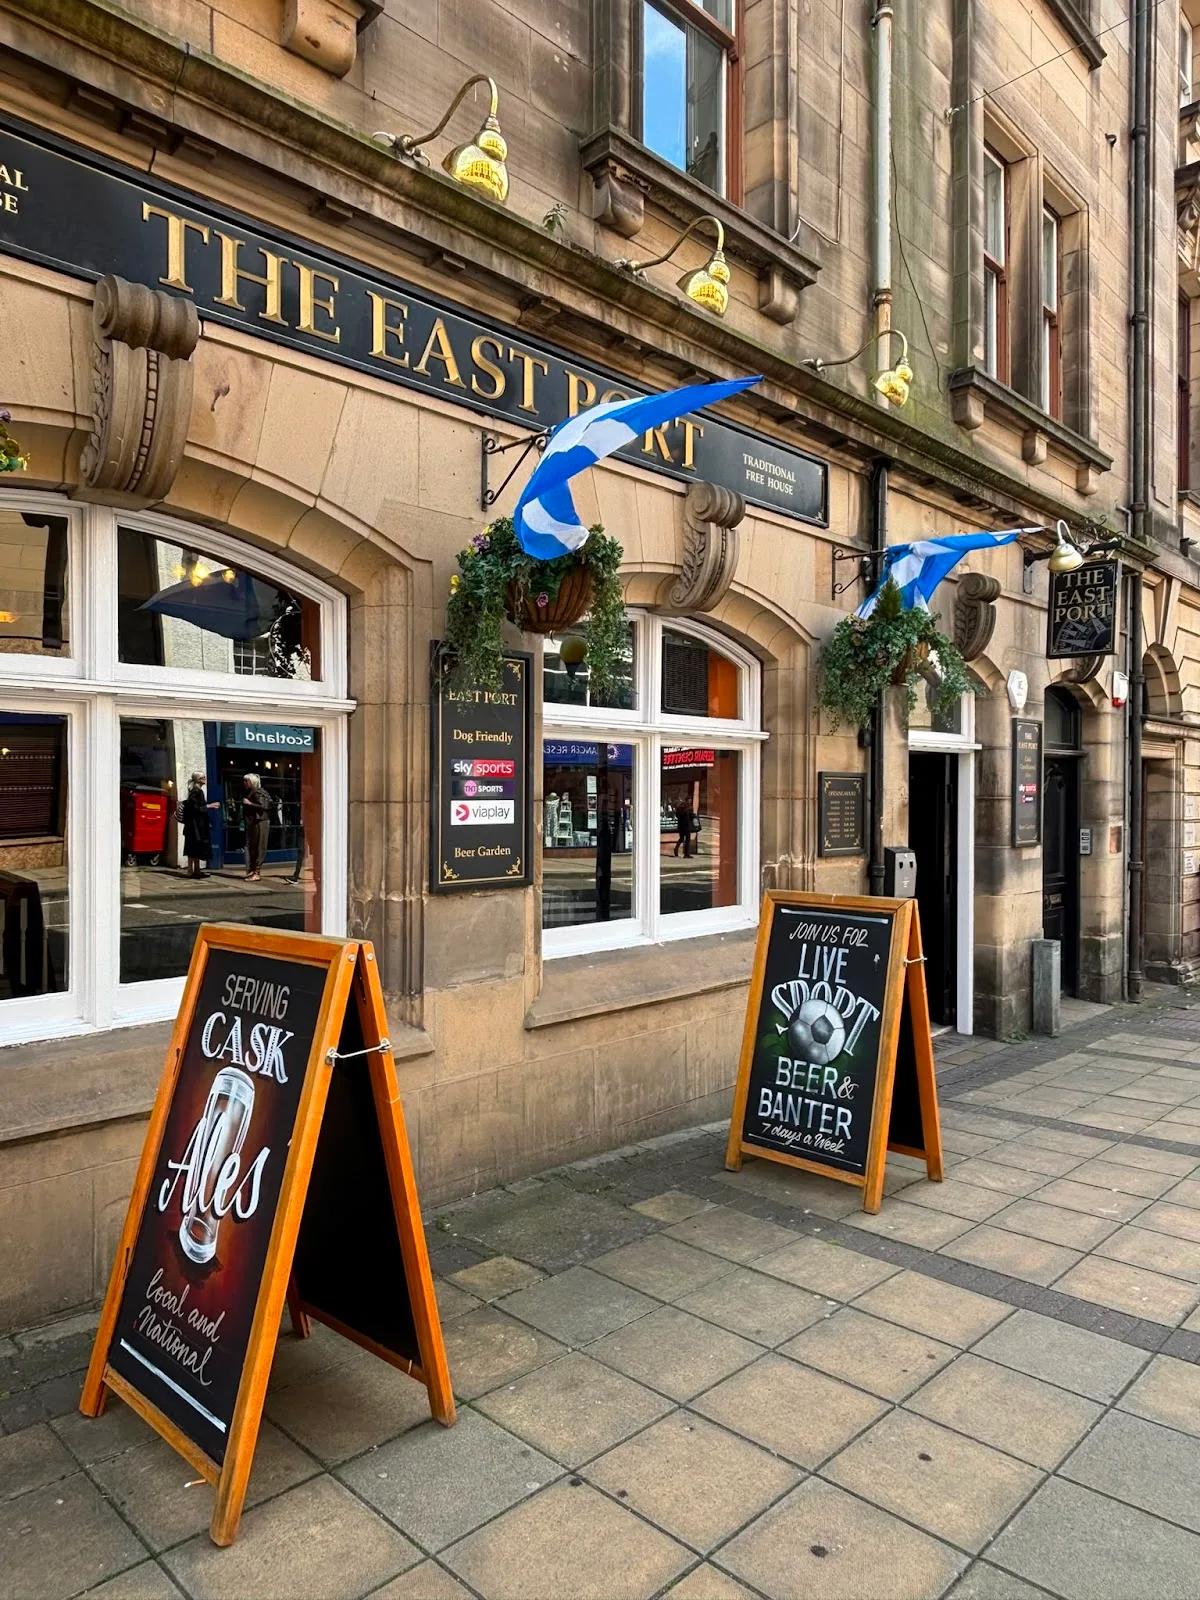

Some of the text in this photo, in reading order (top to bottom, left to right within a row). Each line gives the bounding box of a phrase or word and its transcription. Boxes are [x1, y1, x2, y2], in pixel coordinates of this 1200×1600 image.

[142, 201, 704, 471] THE EAST PRT
[743, 453, 796, 482] TRADITIONAL
[746, 469, 793, 496] FREE HOUSE
[1062, 569, 1104, 588] THE
[1057, 586, 1110, 606] EAST
[1055, 603, 1111, 623] PORT
[449, 688, 518, 706] EAST PORT
[453, 729, 513, 746] Dog Friendly
[453, 760, 513, 776] sky sports
[478, 785, 503, 793] SPORTS
[472, 806, 510, 820] viaplay
[454, 845, 511, 858] Beer Garden
[789, 922, 869, 948] JOIN US FOR
[798, 943, 849, 984] LIVE
[221, 974, 290, 1020] SERVING
[201, 1012, 294, 1084] CASK
[775, 1056, 859, 1100] BEER &
[758, 1087, 852, 1140] BANTER
[761, 1122, 771, 1134] 7
[771, 1124, 802, 1146] days
[803, 1133, 813, 1145] a
[159, 1111, 271, 1219] Ales
[188, 1308, 226, 1343] and
